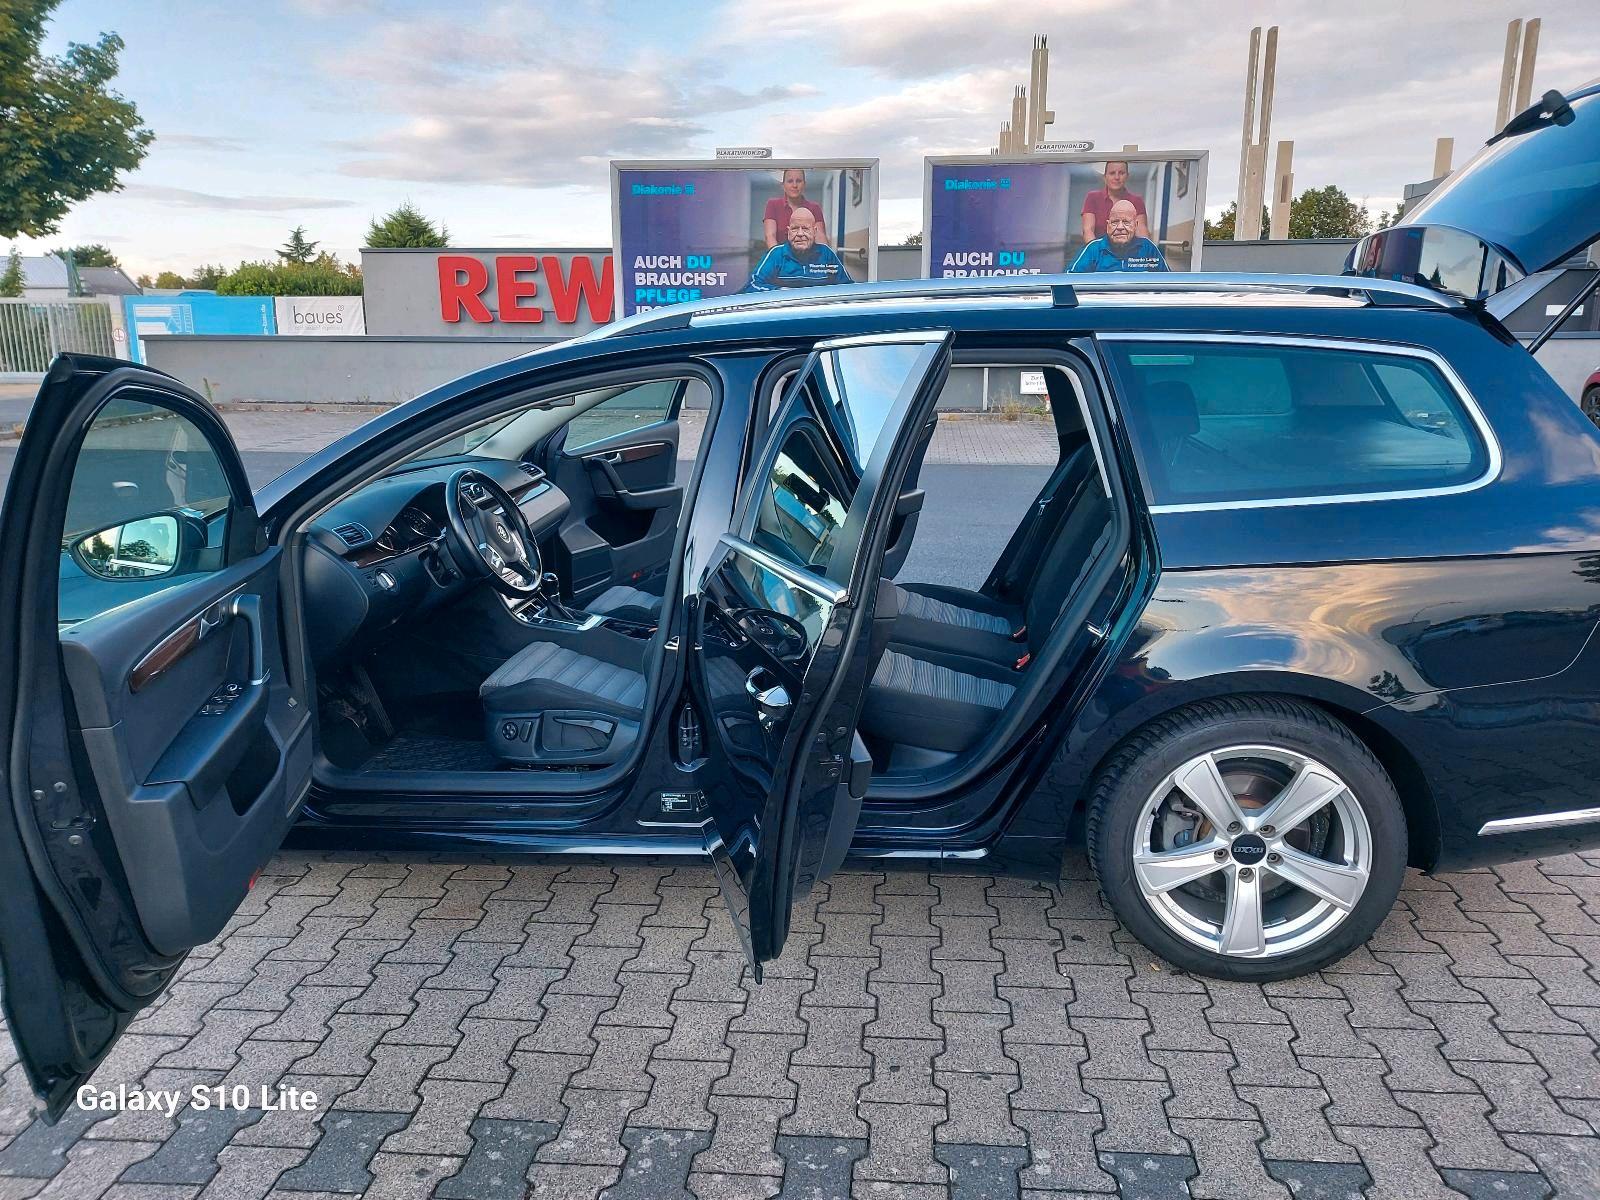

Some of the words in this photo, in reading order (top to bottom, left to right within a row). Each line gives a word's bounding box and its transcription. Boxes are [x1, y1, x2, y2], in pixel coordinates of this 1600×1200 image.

[633, 255, 682, 269] AUCH
[687, 255, 712, 269] DU
[942, 252, 993, 266] AUCH
[999, 251, 1025, 266] DU
[634, 272, 728, 286] BRAUCHST
[635, 288, 702, 303] PFLEGE
[293, 305, 343, 324] baues
